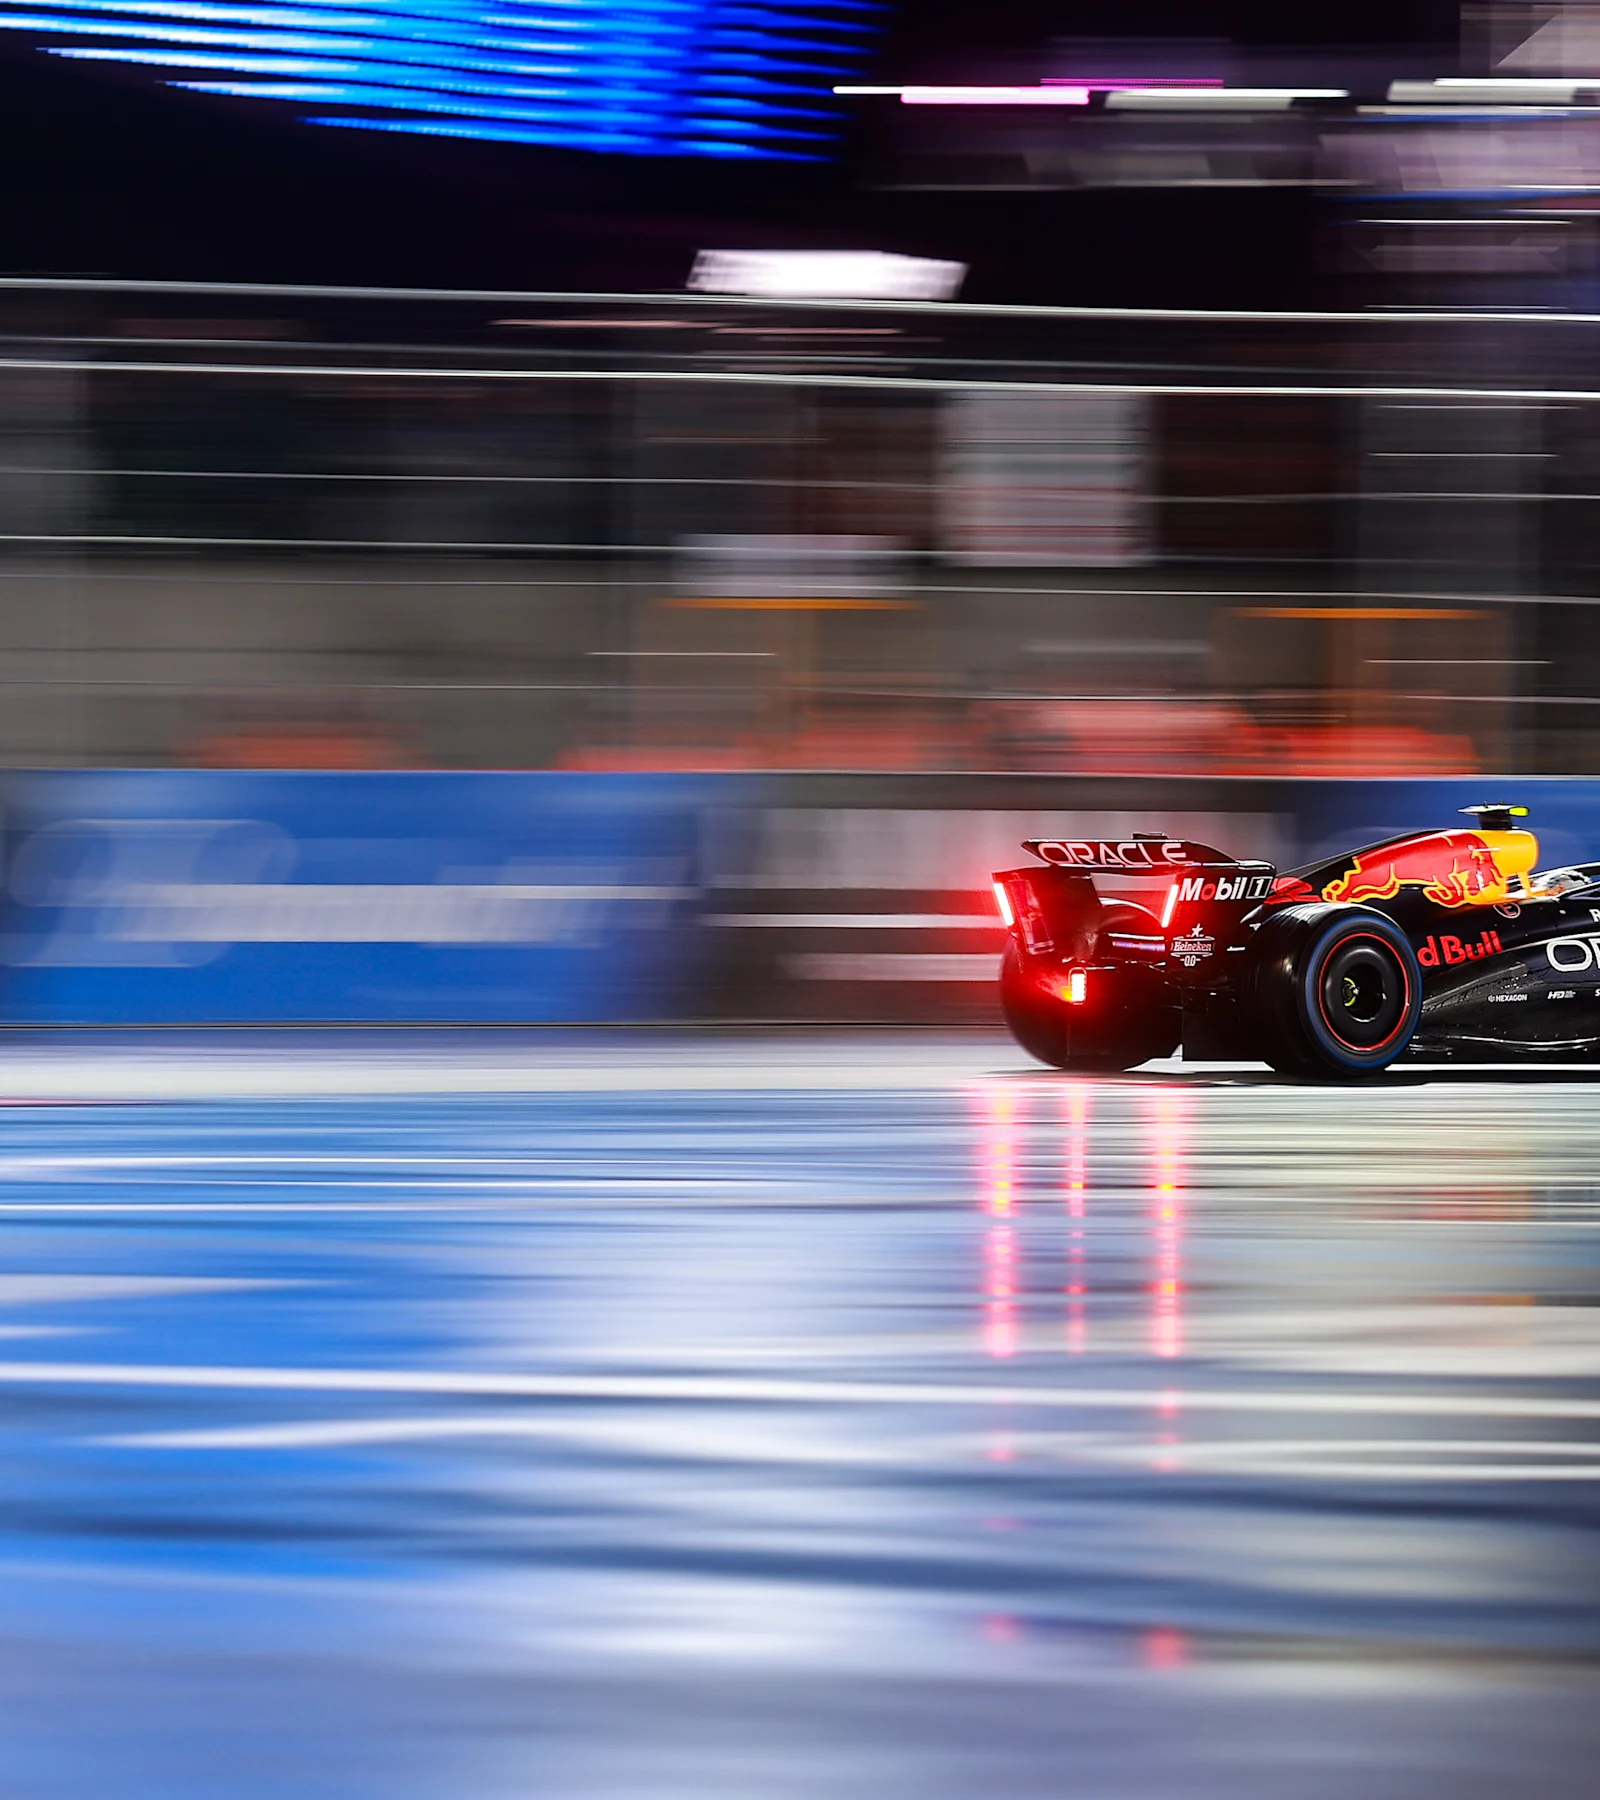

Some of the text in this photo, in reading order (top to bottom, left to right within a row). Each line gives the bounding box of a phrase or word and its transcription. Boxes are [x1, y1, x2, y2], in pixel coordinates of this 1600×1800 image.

[1038, 842, 1194, 866] ORACLE
[1179, 877, 1248, 901] Mobil
[1173, 942, 1212, 952] Heineken
[1440, 930, 1503, 964] Bull
[1496, 994, 1528, 1002] HEXAGON
